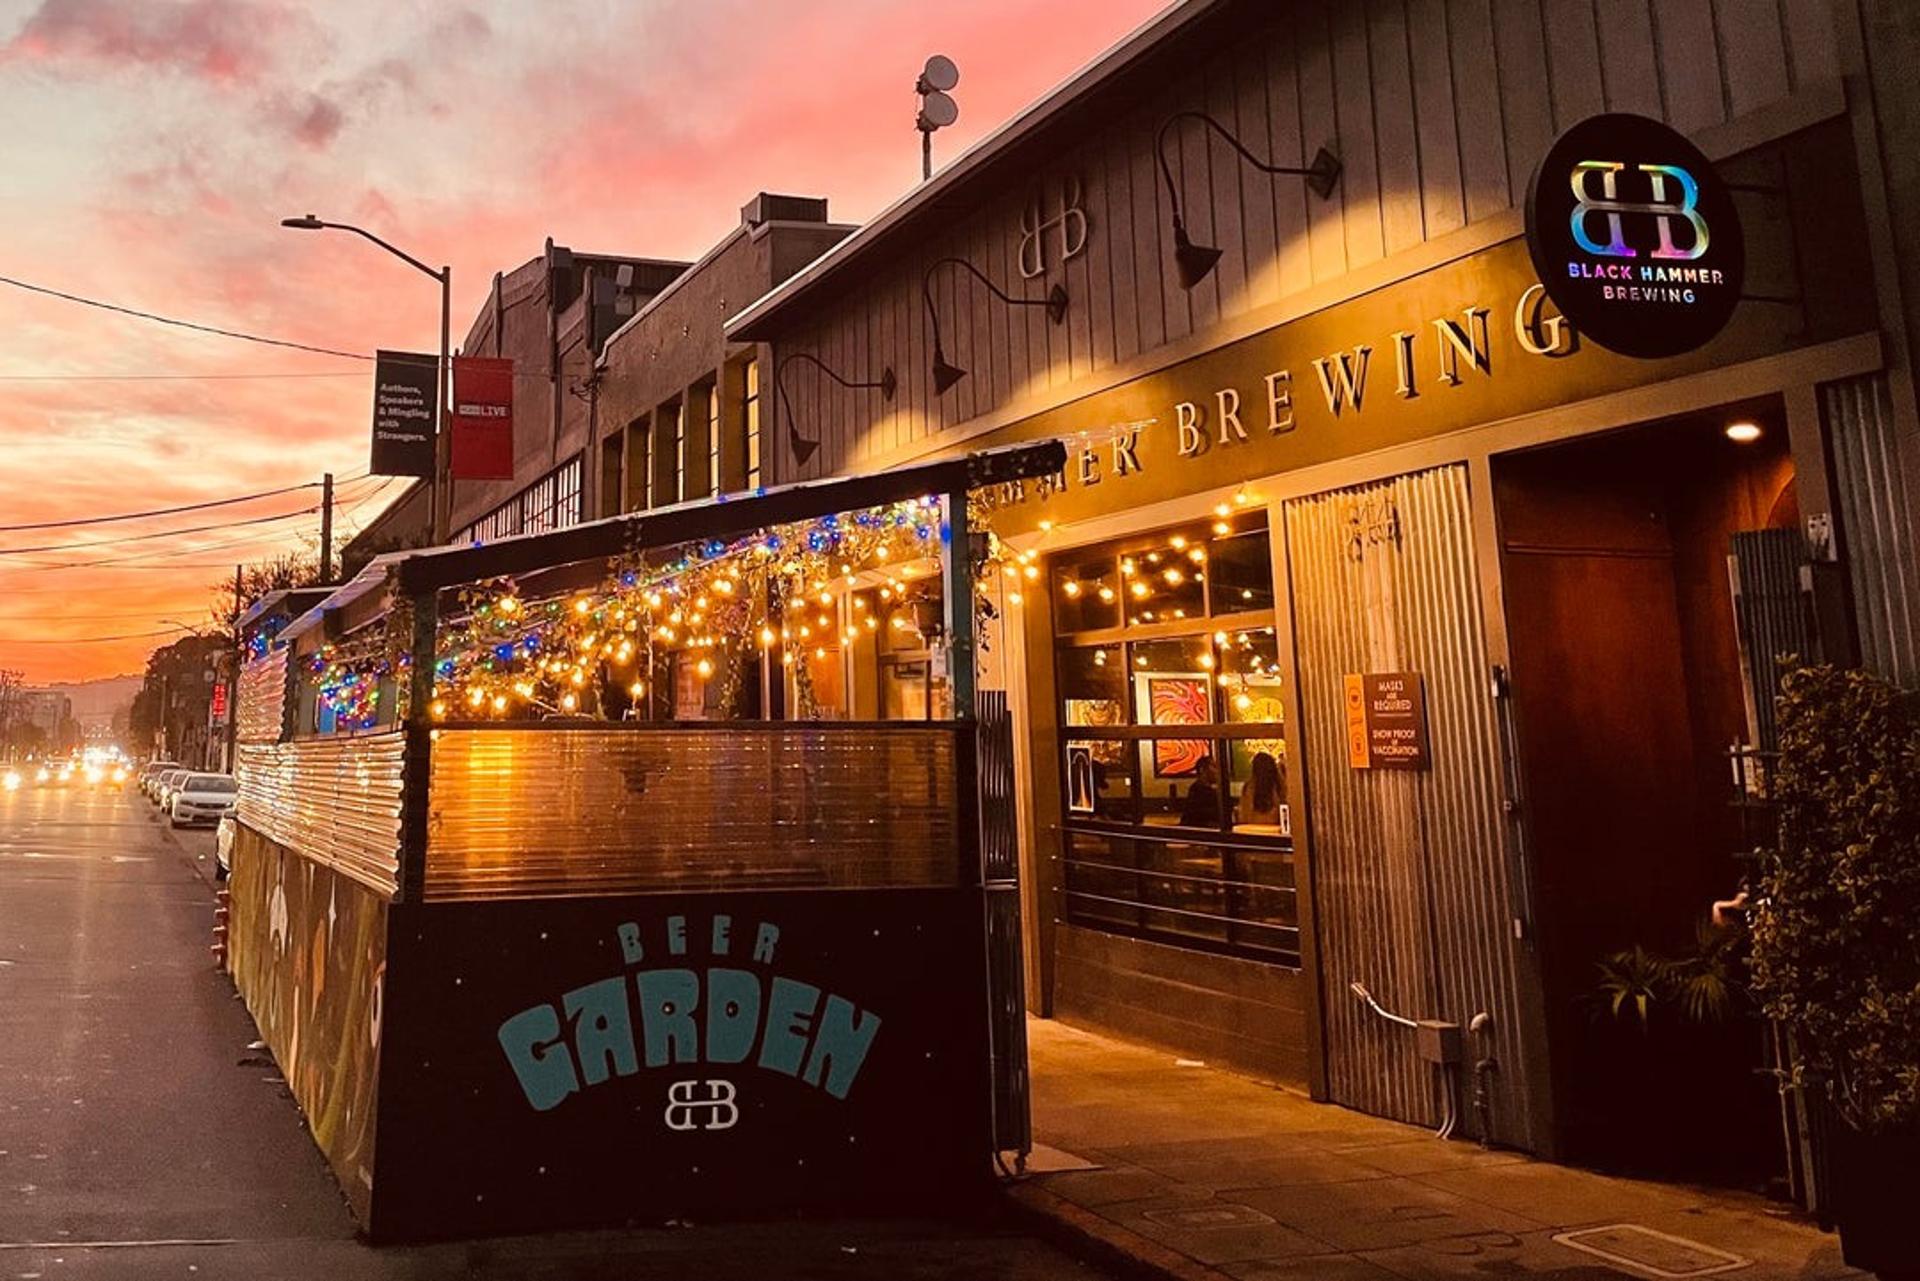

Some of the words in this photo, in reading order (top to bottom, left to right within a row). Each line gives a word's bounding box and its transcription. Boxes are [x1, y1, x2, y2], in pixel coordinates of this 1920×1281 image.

[1567, 261, 1633, 280] BLACK
[1640, 266, 1724, 284] HAMMER
[1602, 285, 1696, 303] BREWING
[1175, 283, 1566, 457] BREWING
[380, 383, 422, 395] Authors,
[379, 395, 424, 406] Speakers
[378, 406, 386, 416] &
[387, 407, 431, 419] Mingling
[378, 418, 400, 428] with
[1373, 699, 1412, 711] REQUIRED
[617, 914, 780, 965] BEER
[497, 967, 883, 1112] GARDEN
